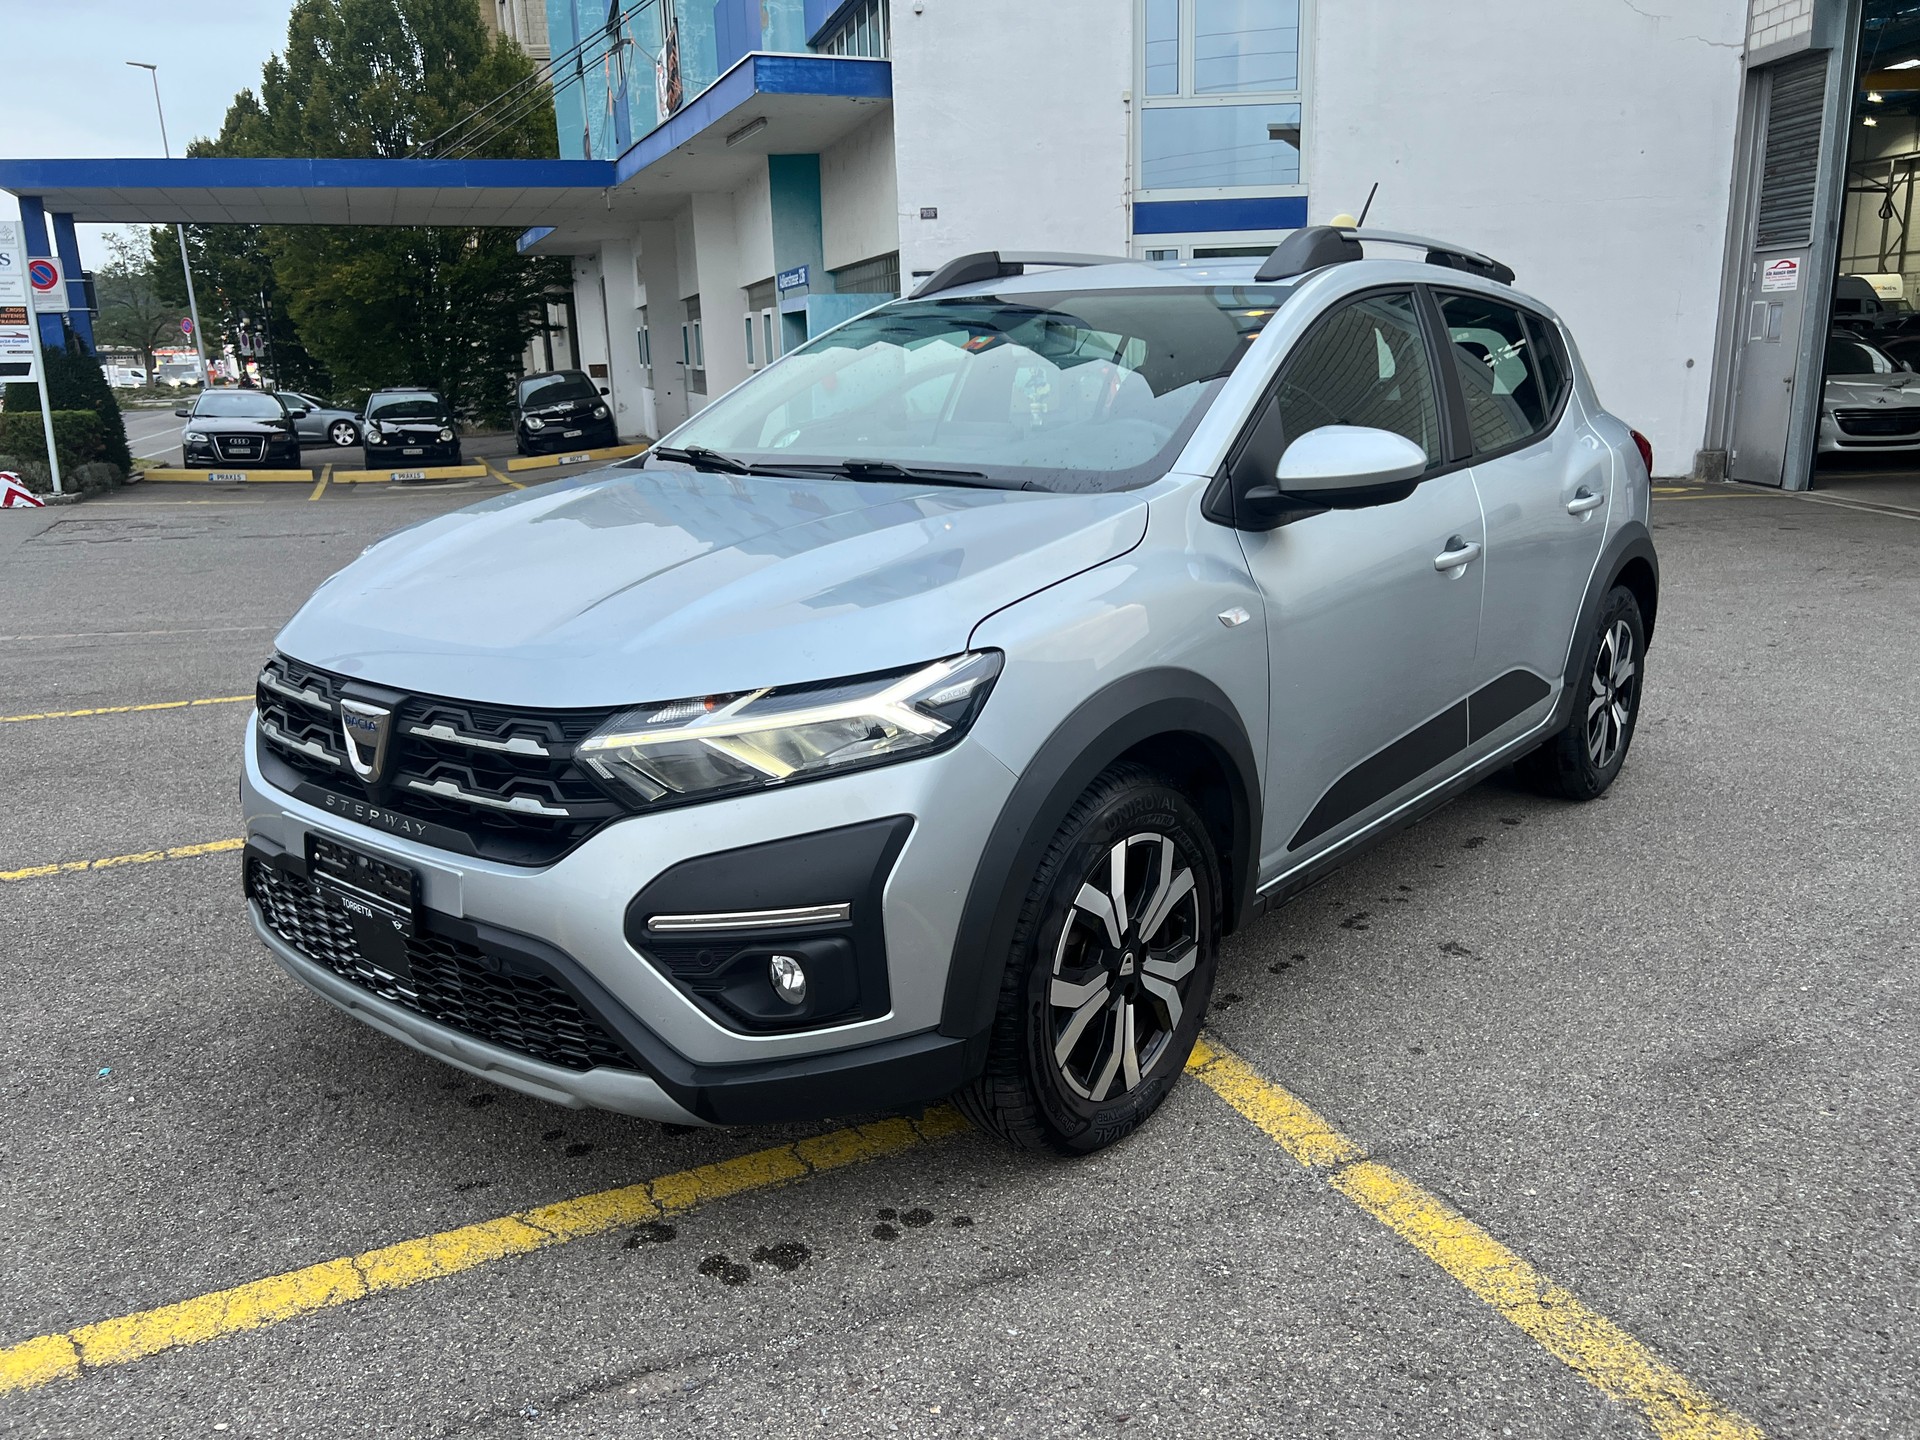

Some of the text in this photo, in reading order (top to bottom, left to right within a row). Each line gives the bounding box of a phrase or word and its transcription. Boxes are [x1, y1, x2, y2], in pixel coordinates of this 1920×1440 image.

[398, 472, 422, 480] PRAXIS
[941, 687, 968, 701] DACIA
[344, 714, 377, 732] DACIA
[325, 794, 427, 836] STEPWAY
[1104, 795, 1178, 832] UNIROYAL
[341, 896, 374, 919] TORRETTA
